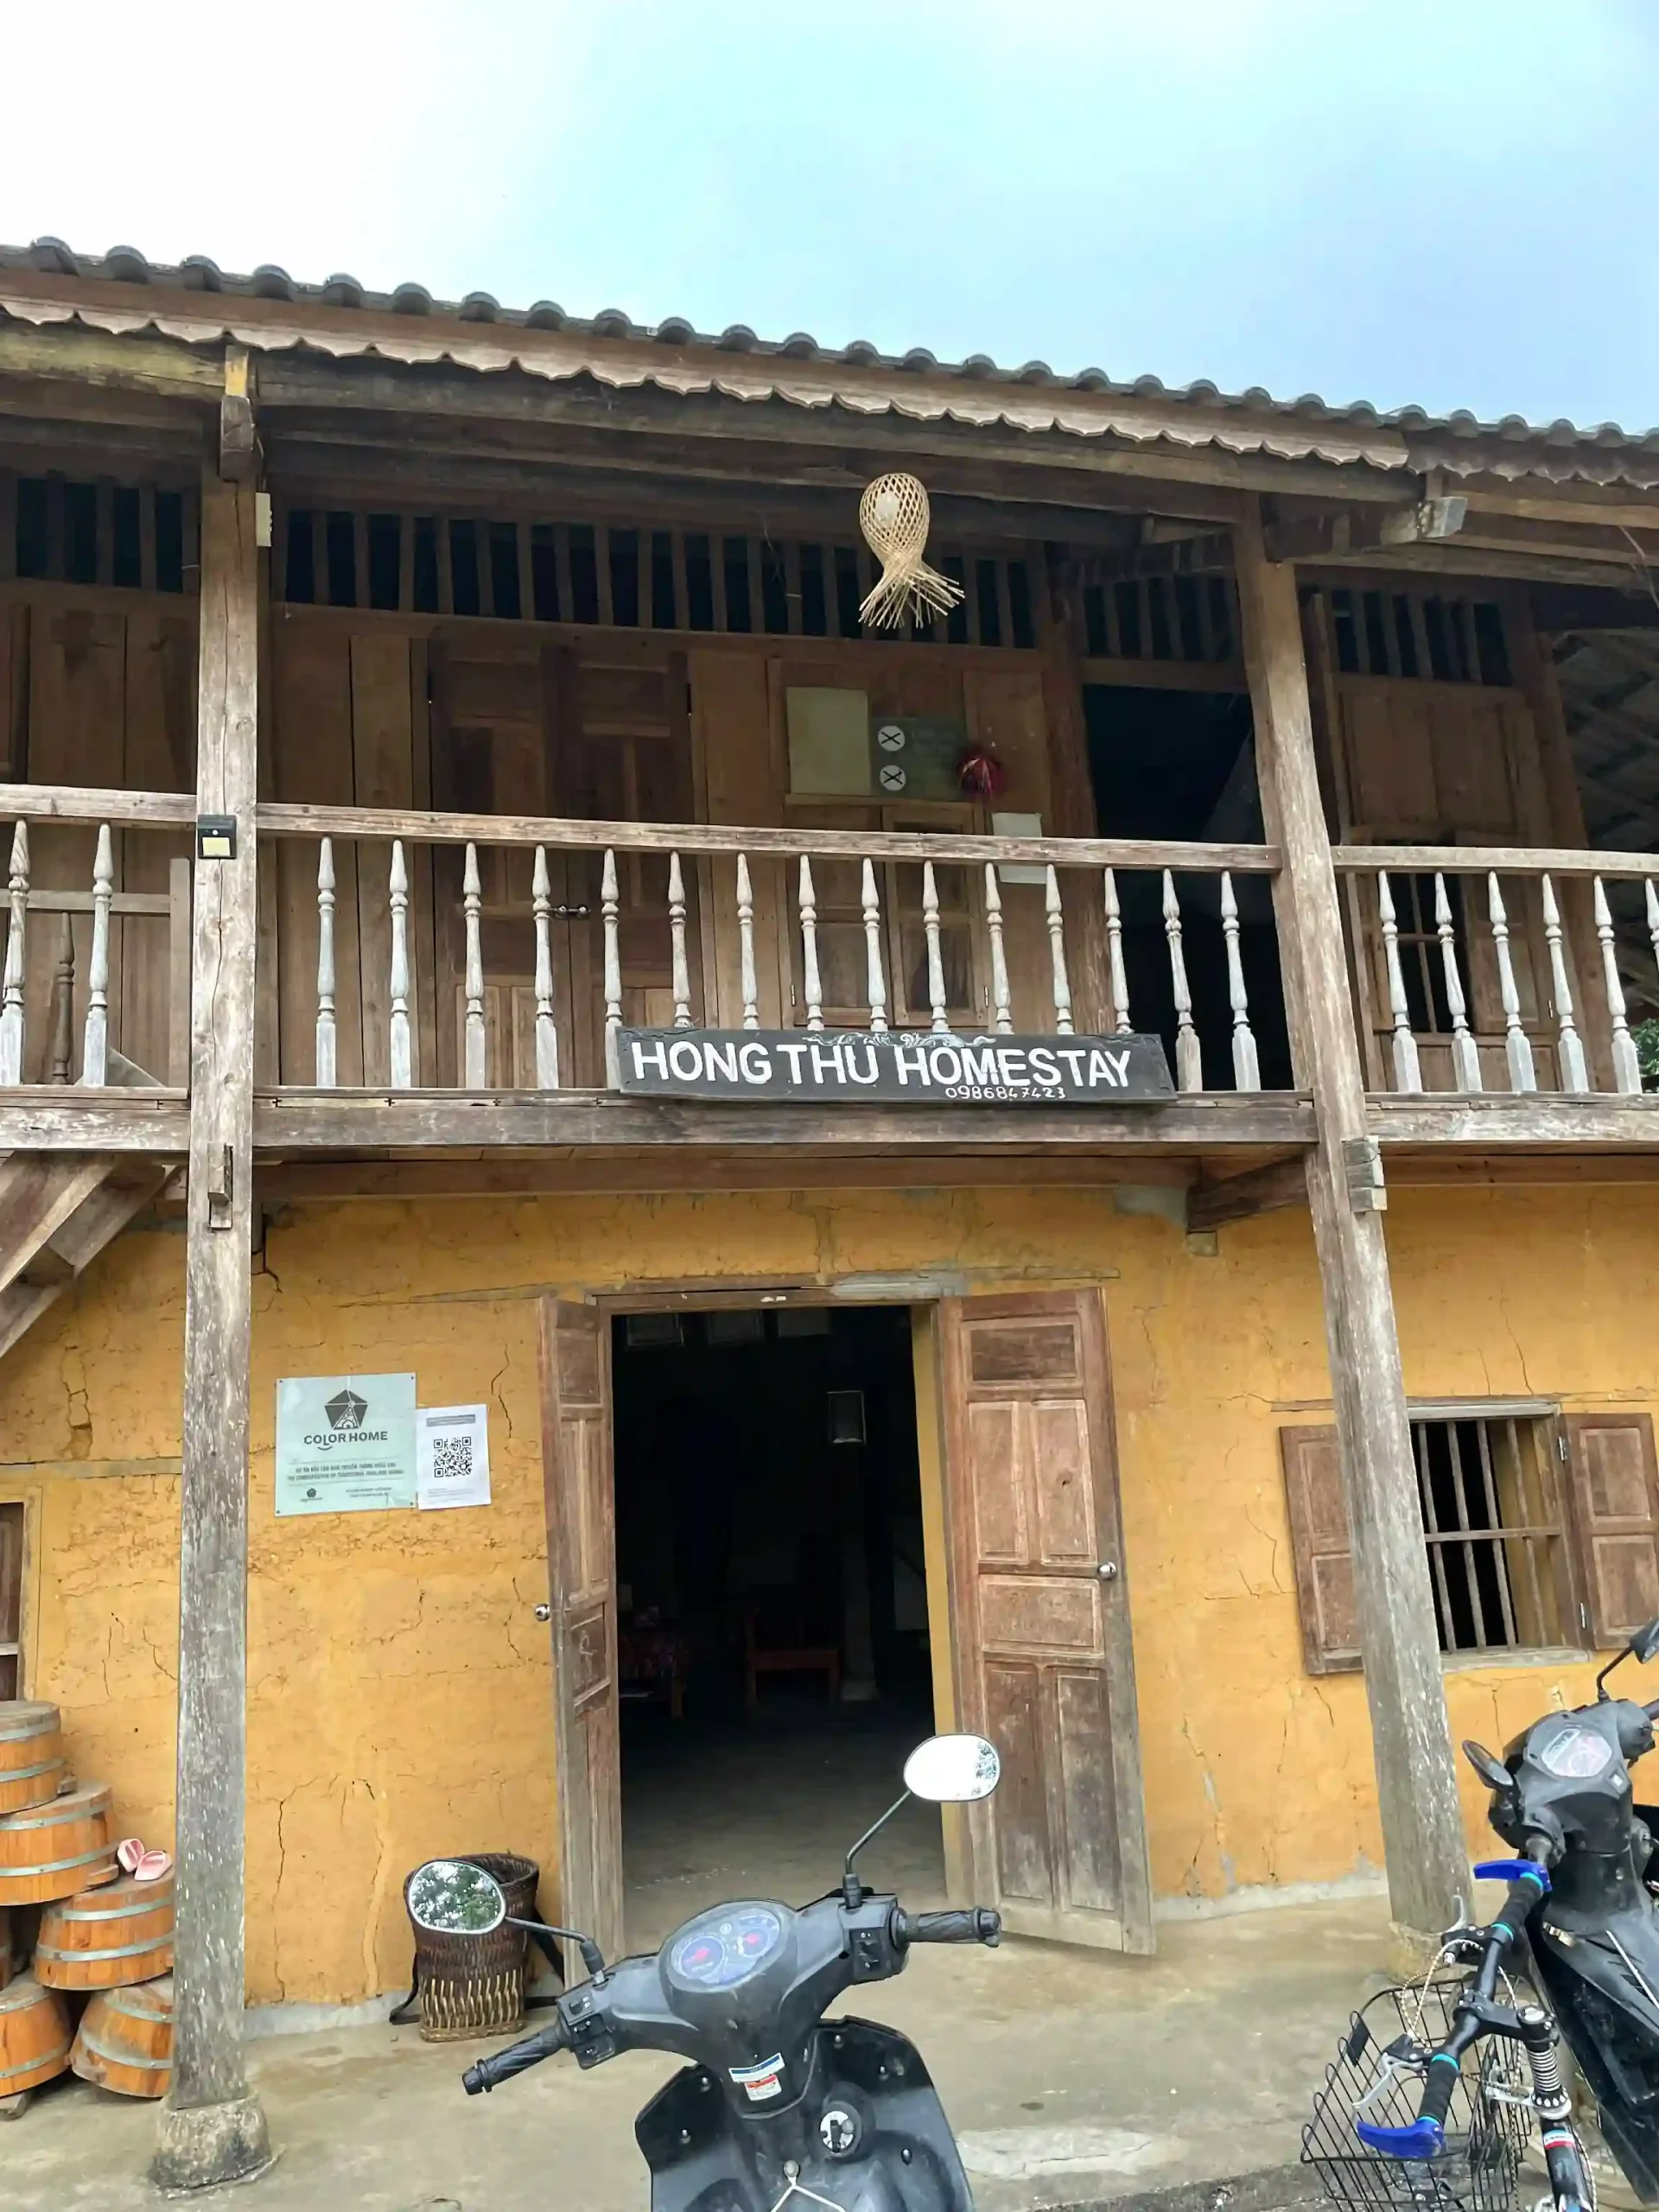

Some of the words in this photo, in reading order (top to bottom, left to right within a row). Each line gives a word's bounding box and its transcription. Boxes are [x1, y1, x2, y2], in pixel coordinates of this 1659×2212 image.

[632, 1040, 772, 1084] HONG
[776, 1044, 880, 1084] THU
[893, 1047, 1131, 1087] HOMESTAY
[945, 1085, 1066, 1100] 0986847423
[303, 1433, 346, 1446] COLOR
[348, 1431, 388, 1442] HOME
